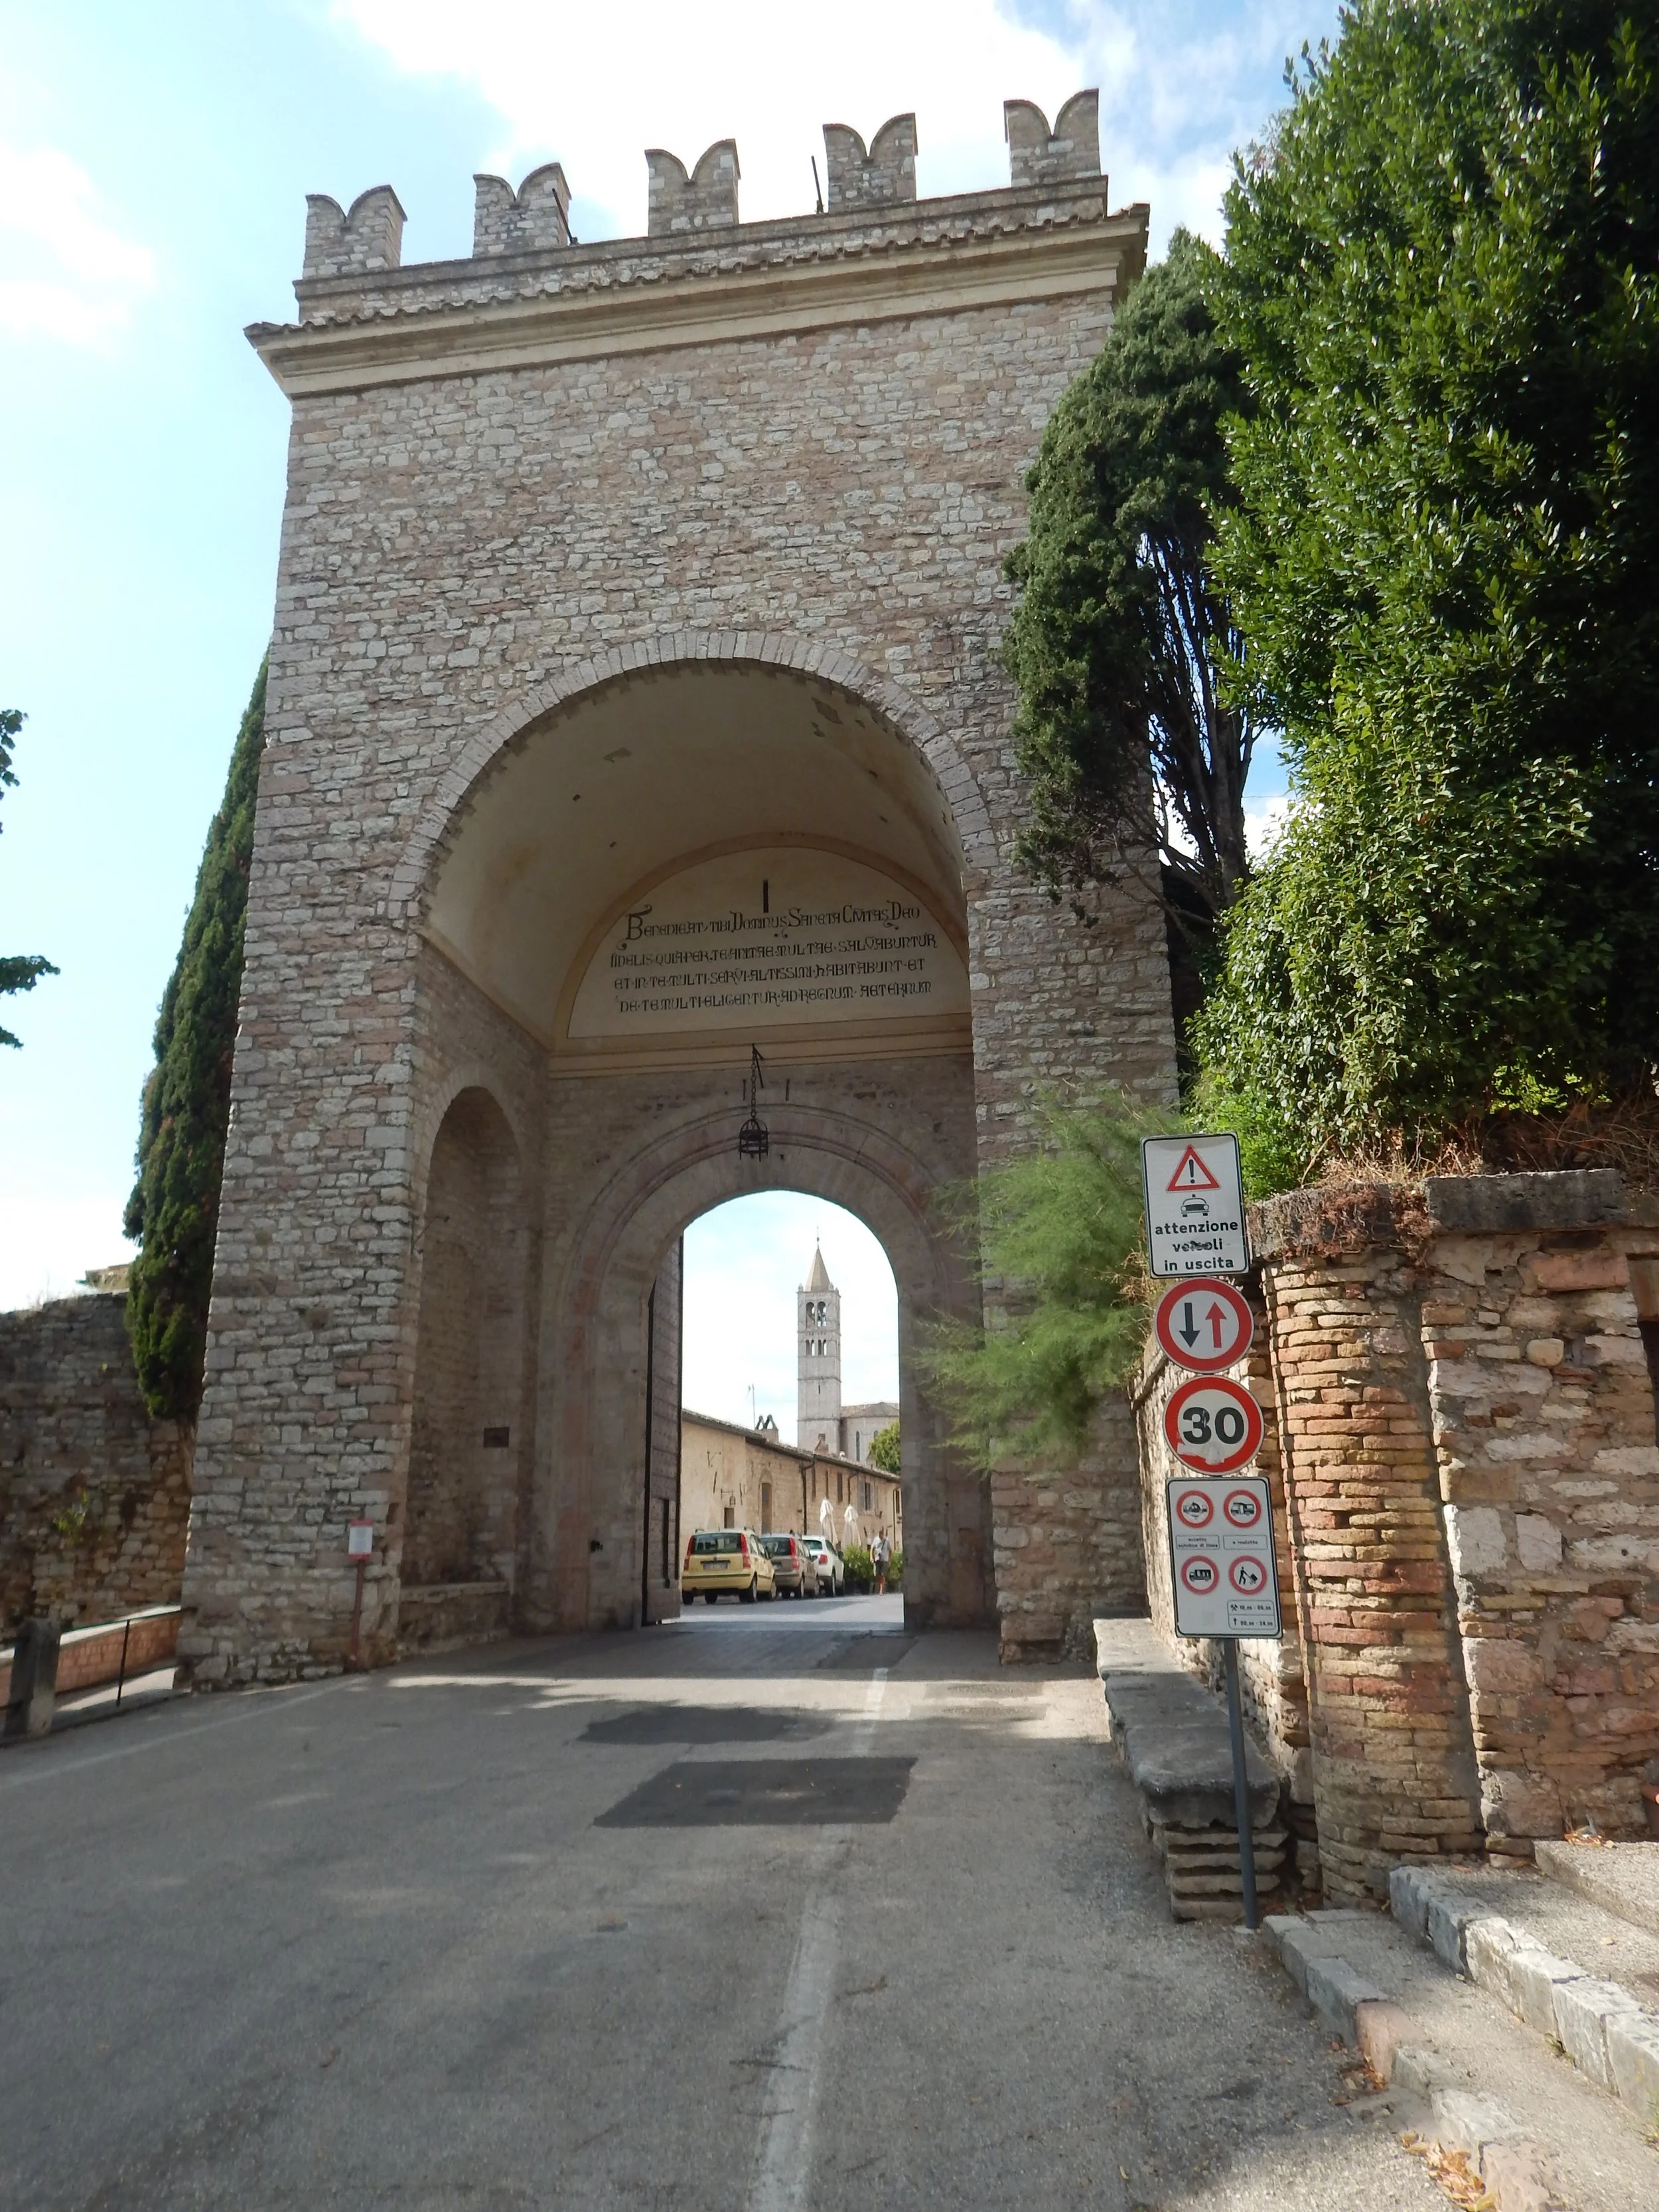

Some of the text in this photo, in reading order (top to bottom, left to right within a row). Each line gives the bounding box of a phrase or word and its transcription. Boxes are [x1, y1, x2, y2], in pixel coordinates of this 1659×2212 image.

[1154, 1220, 1239, 1236] attenzione
[1164, 1256, 1234, 1272] in uscita
[1183, 1406, 1245, 1445] 30
